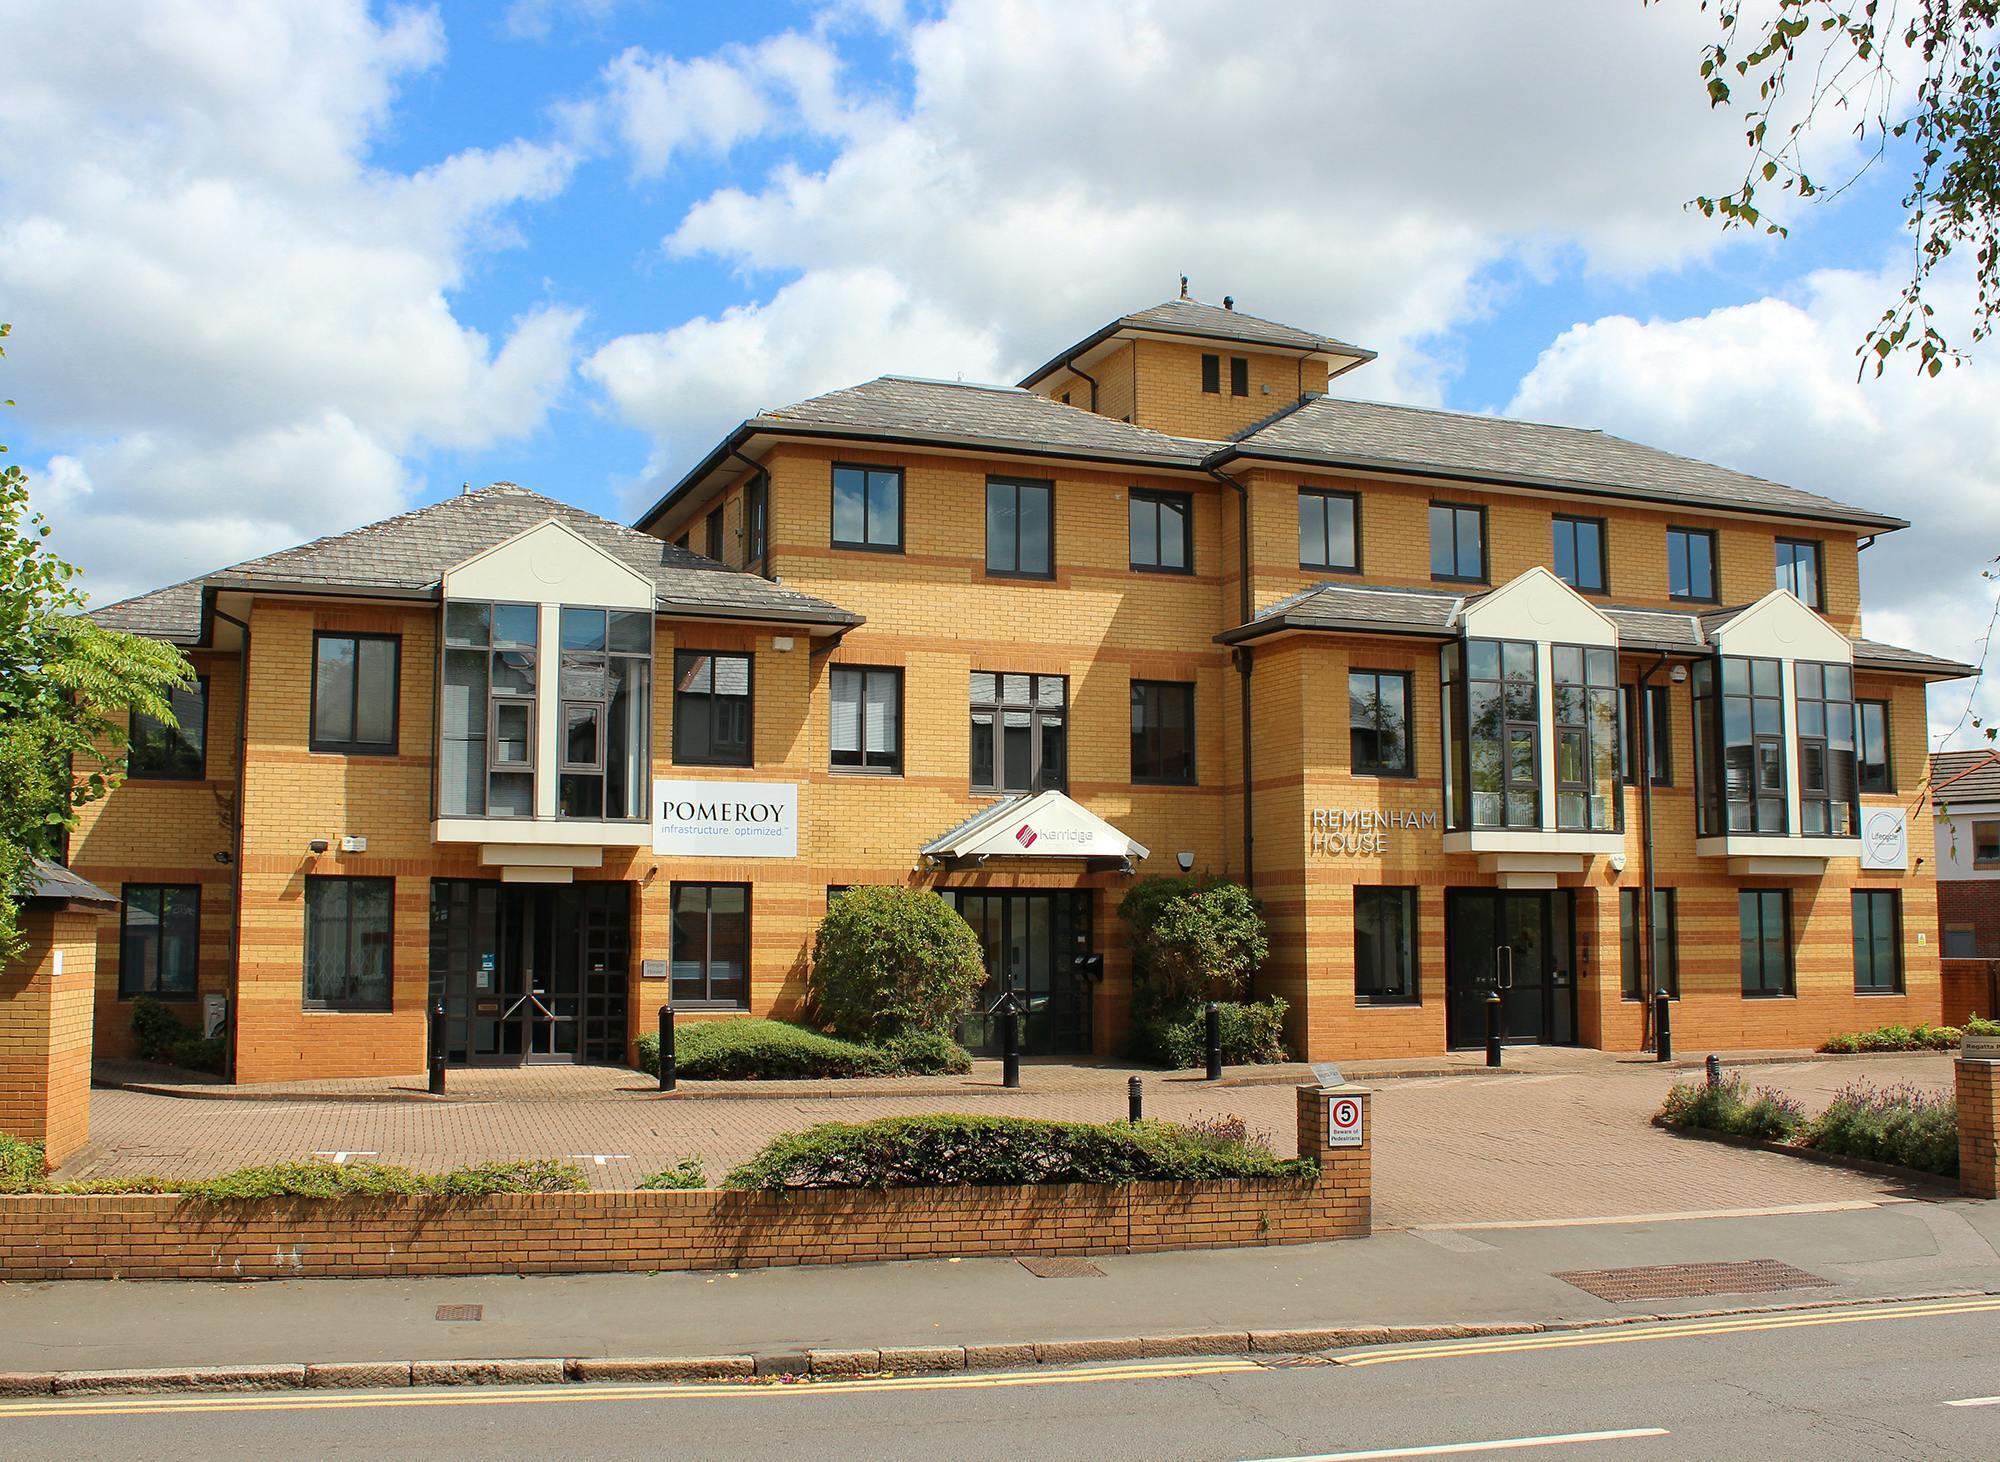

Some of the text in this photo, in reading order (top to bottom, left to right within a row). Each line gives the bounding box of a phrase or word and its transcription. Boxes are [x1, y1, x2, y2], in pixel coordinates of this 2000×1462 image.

[662, 801, 785, 823] POMEROY
[1312, 808, 1437, 830] REMENHAM
[661, 823, 732, 836] infrastructure.
[1312, 832, 1388, 852] HOUSE
[1341, 1105, 1351, 1121] 5
